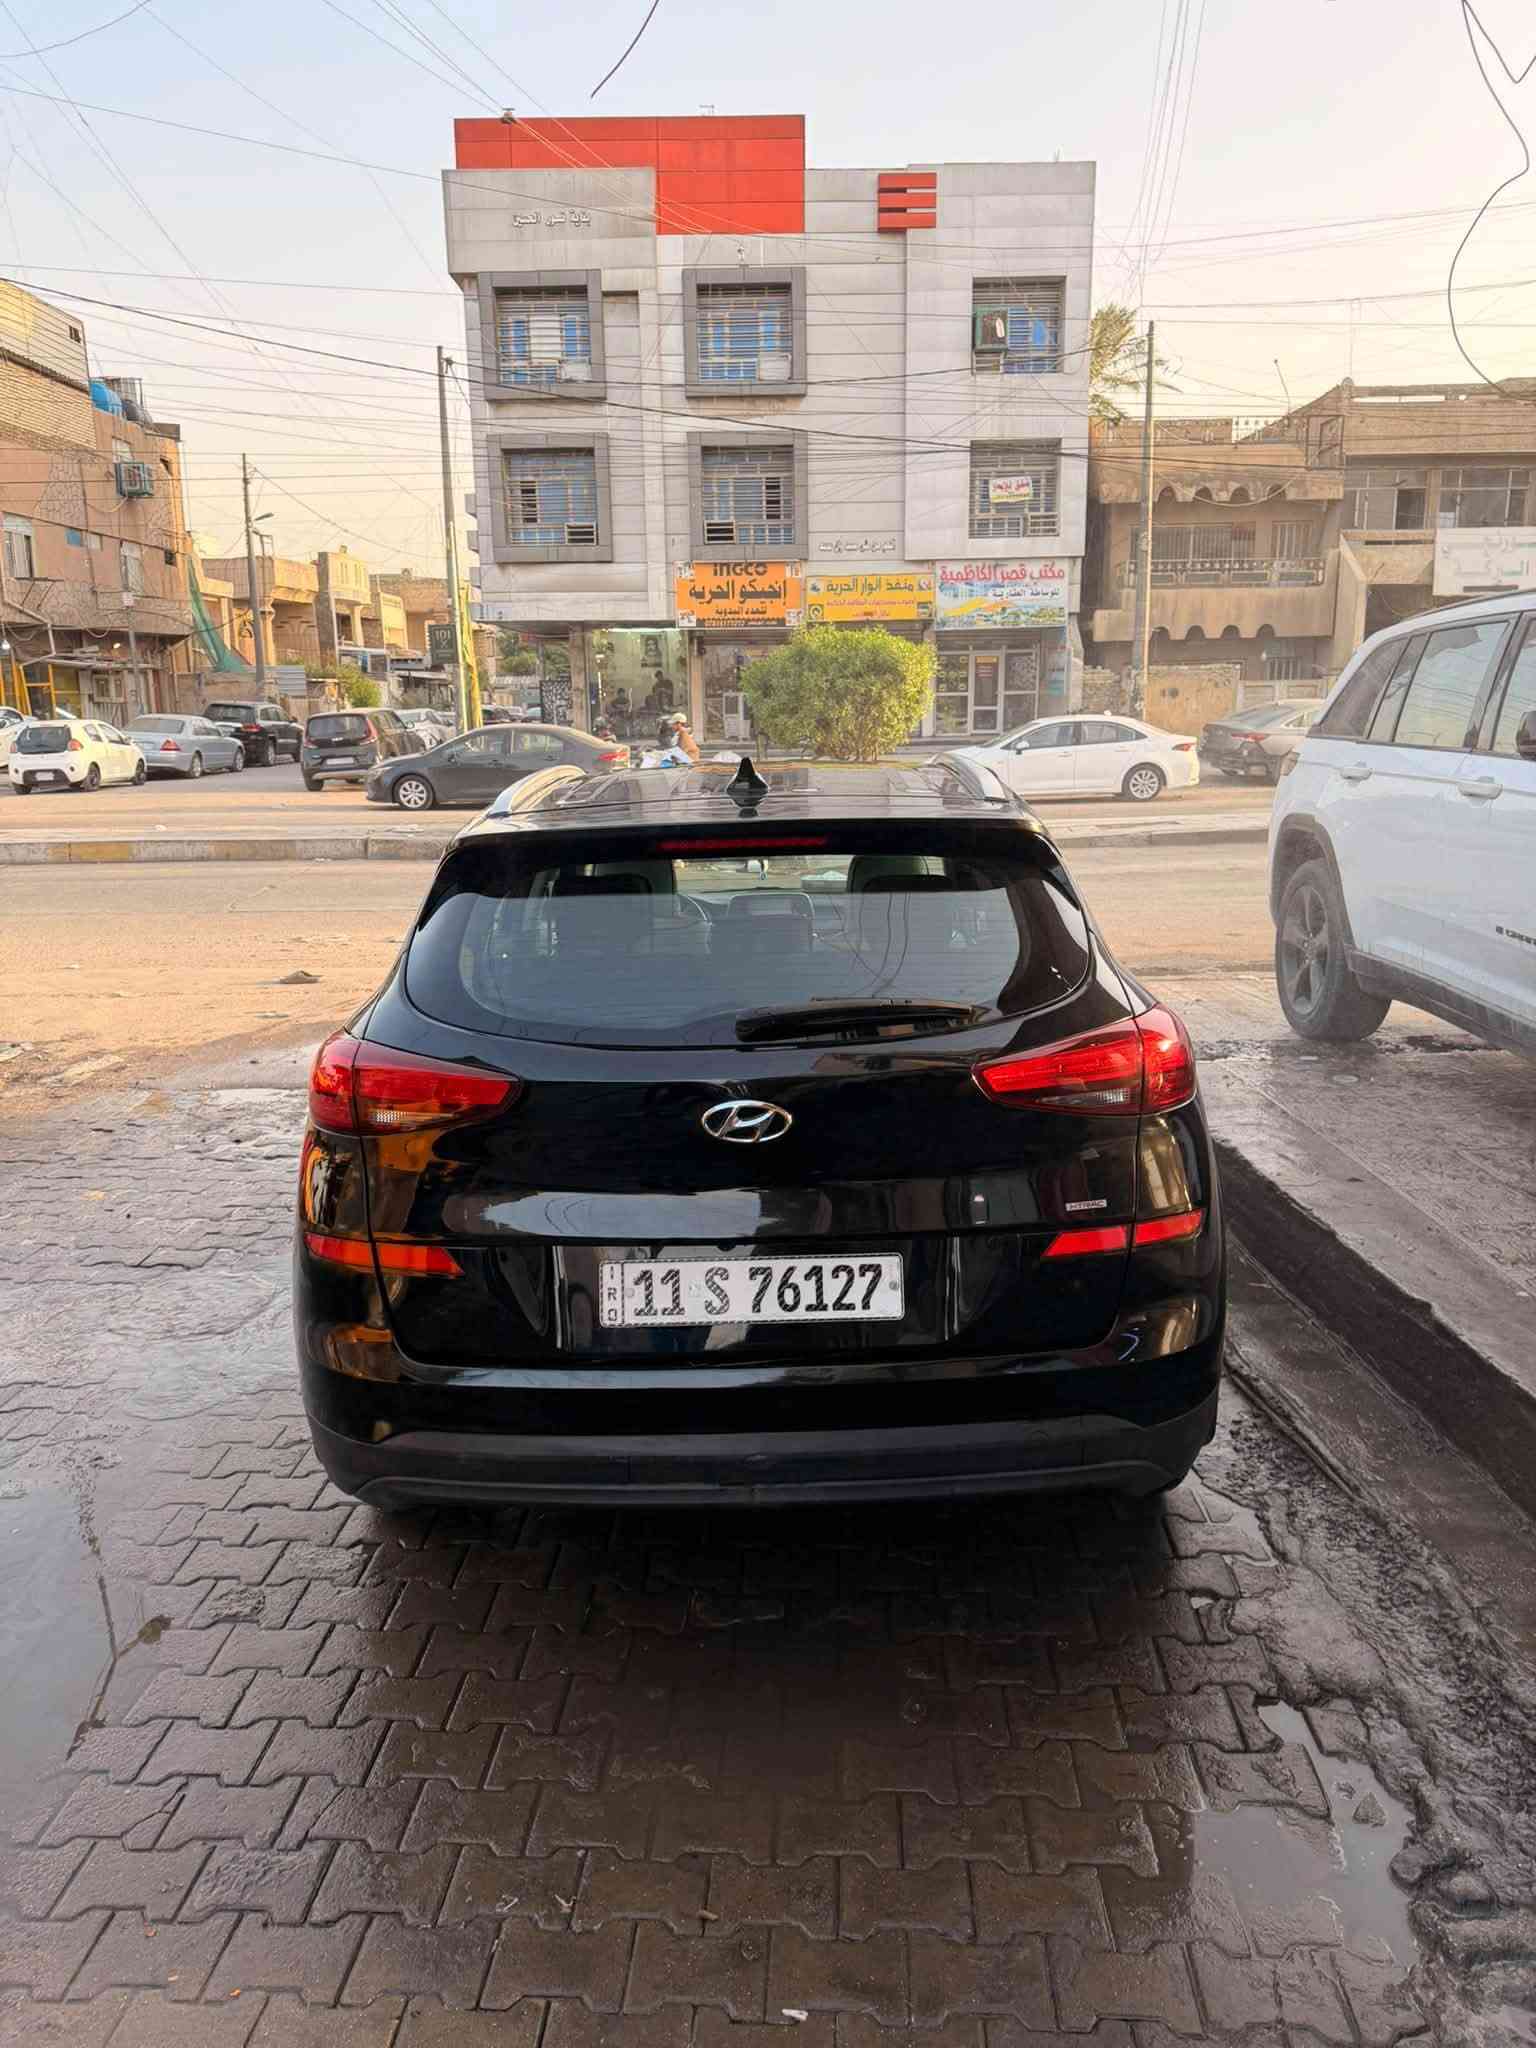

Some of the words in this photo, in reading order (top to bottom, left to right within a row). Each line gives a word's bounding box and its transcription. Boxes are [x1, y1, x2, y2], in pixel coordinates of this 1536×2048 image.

[940, 562, 998, 584] الكاظمية
[999, 564, 1026, 583] قصر
[1029, 560, 1065, 585] مكتب
[689, 579, 735, 605] الحرية
[738, 579, 787, 606] إنجيكو
[633, 1267, 685, 1317] 11
[703, 1266, 730, 1316] S
[748, 1263, 884, 1314] 76127
